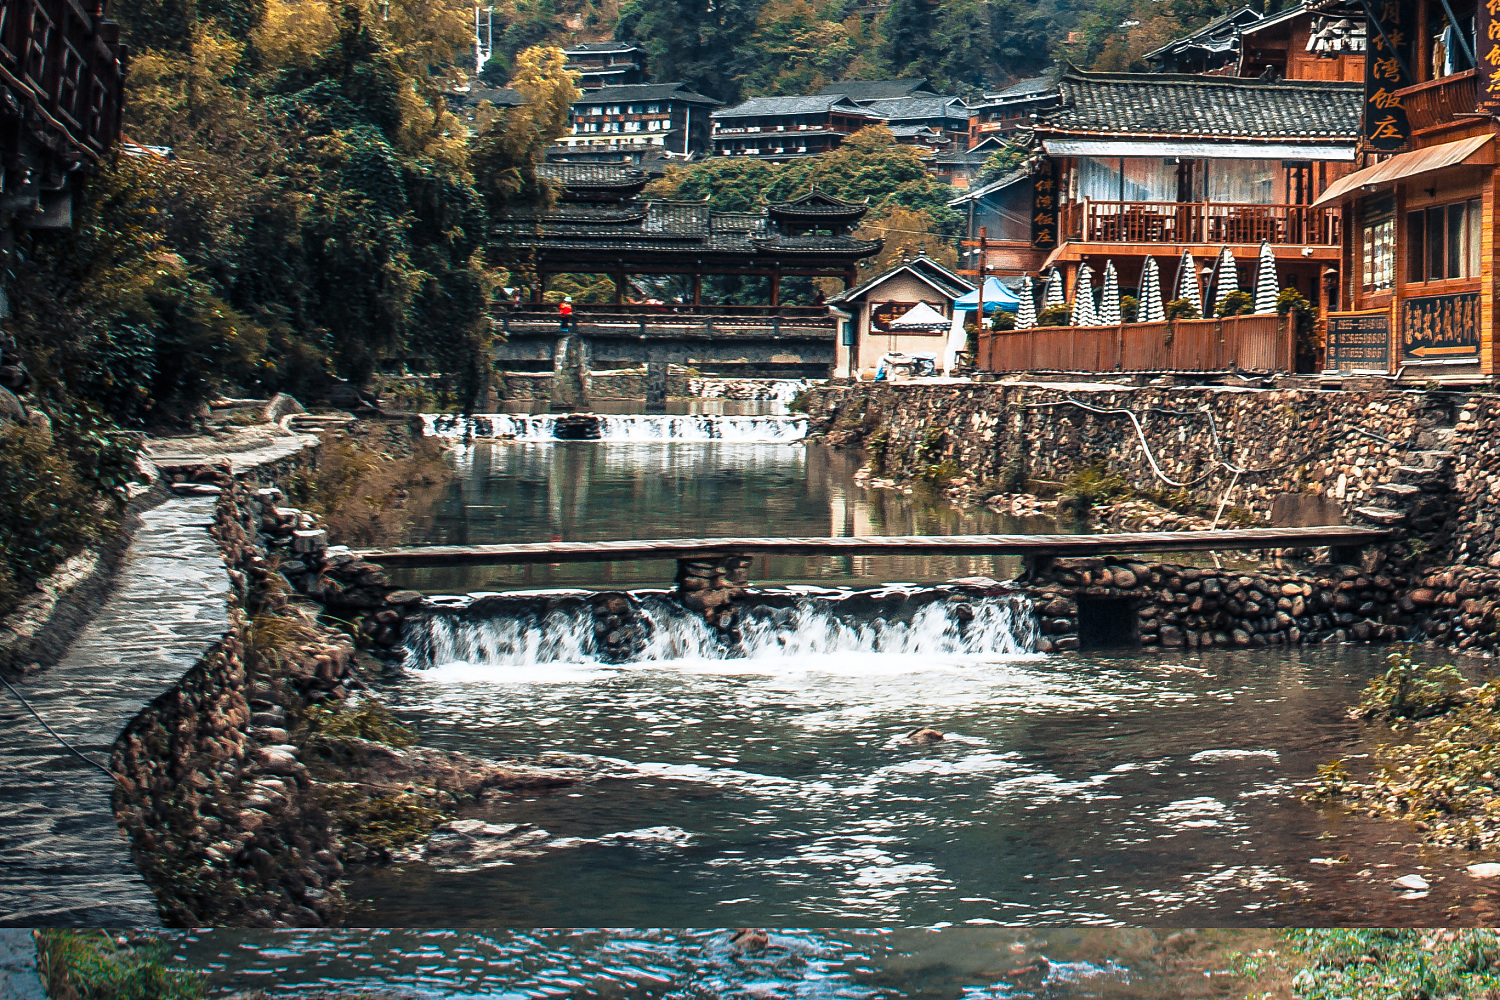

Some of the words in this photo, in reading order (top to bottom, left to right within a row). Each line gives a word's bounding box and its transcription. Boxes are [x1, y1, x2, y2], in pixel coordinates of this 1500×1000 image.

[1369, 1, 1407, 140] 月伴湾饭庄
[1034, 162, 1056, 244] 月伴湾饭庄
